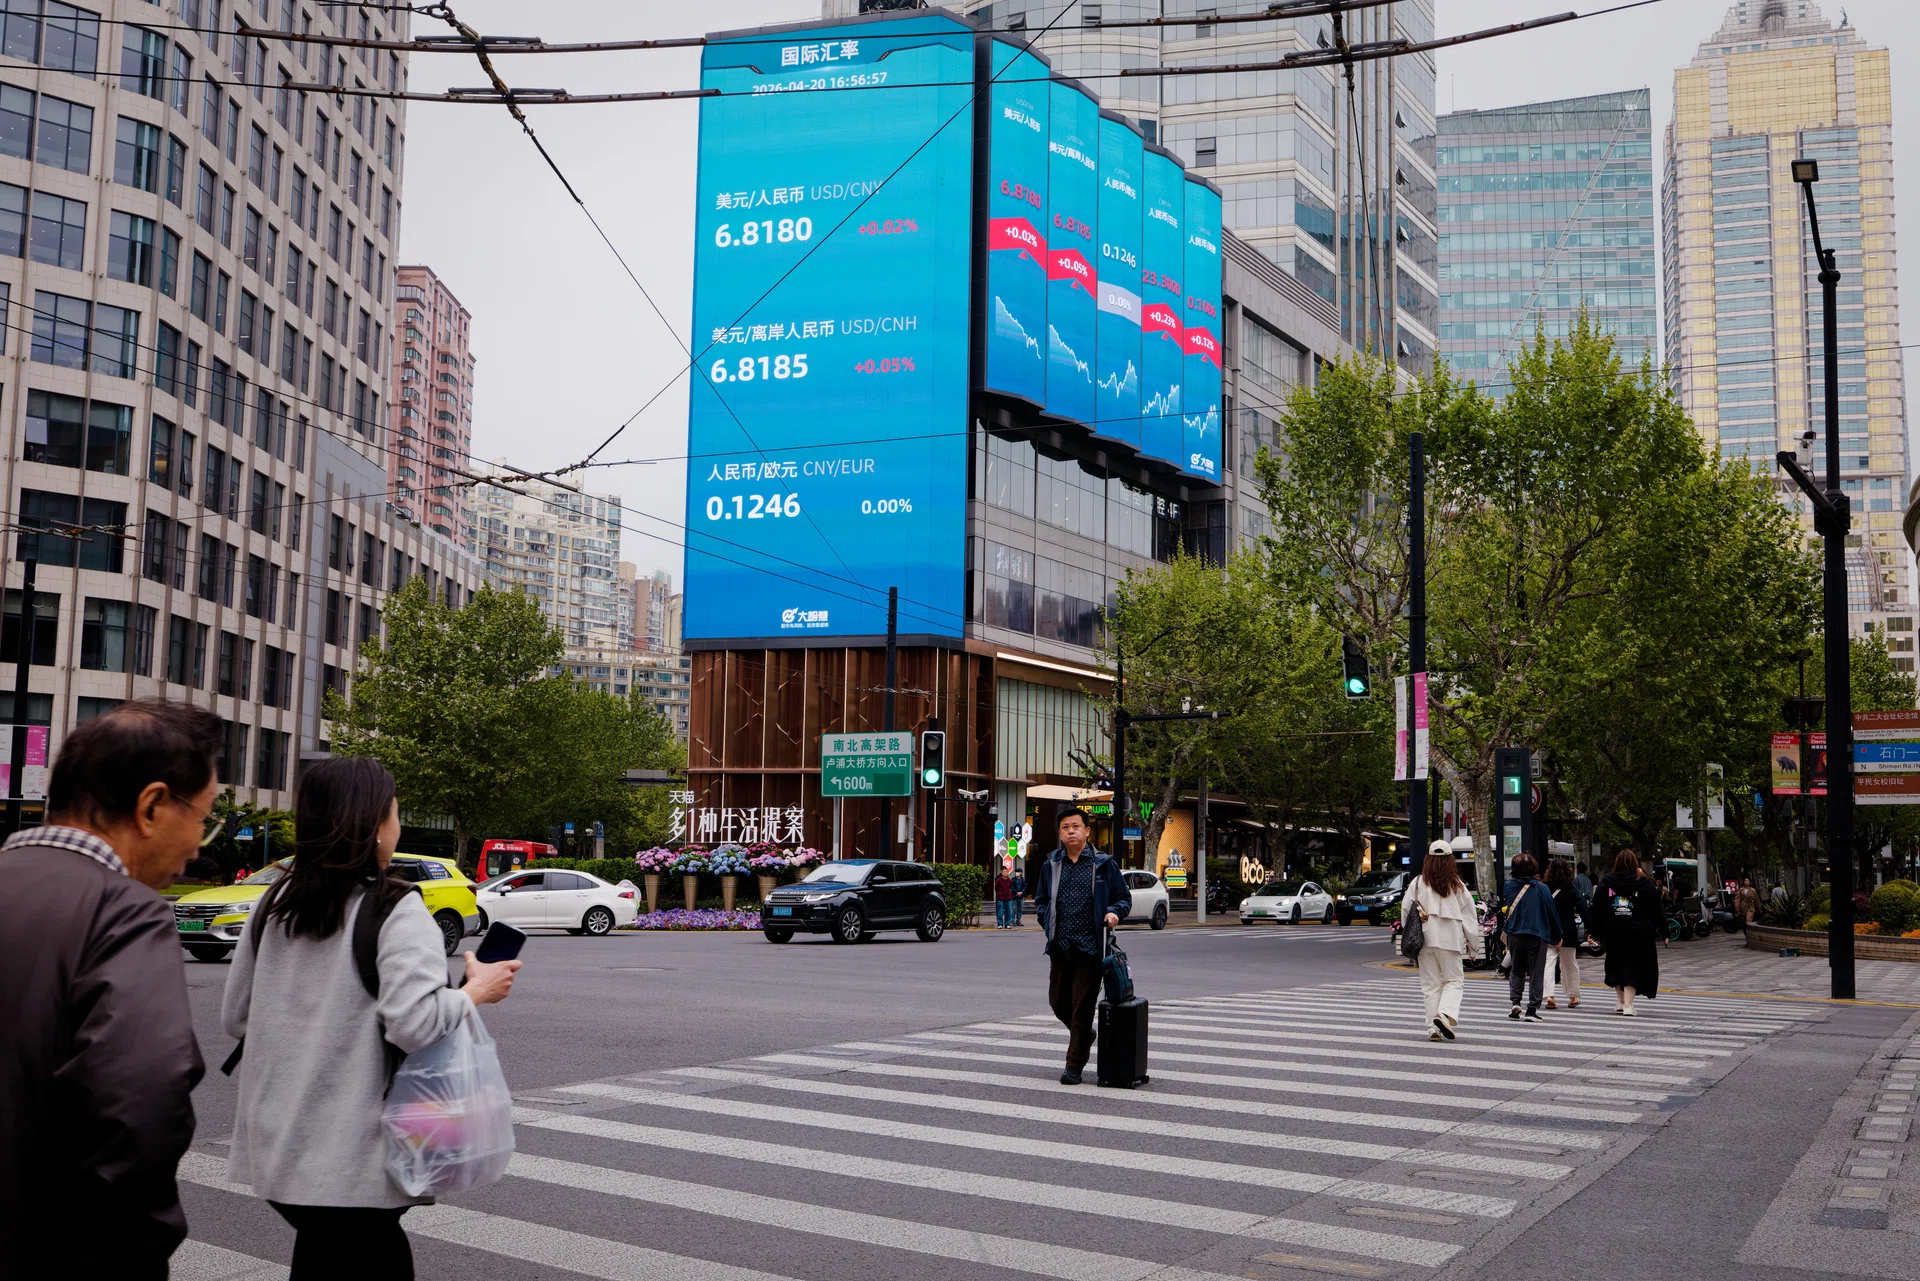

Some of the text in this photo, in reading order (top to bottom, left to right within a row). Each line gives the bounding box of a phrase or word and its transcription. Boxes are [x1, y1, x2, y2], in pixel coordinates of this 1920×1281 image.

[781, 40, 859, 67] 国际汇率
[752, 72, 887, 97] 2026-04-20 16:56:57
[1004, 107, 1040, 132] 美元/人民币
[715, 180, 883, 210] 美元/人民币 USD/CNY
[1001, 180, 1041, 209] 6.8180
[715, 217, 812, 248] 6.8180
[858, 218, 918, 236] +0.02%
[1005, 227, 1037, 247] +0.02%
[1054, 214, 1091, 240] 6.8185
[1102, 243, 1136, 268] 0.1246
[1058, 258, 1088, 277] +0.05%
[1142, 269, 1180, 296] 23.3000
[1109, 295, 1132, 311] 0.00%
[711, 315, 916, 344] 美元/离岸人民币 USD/CNH
[1150, 312, 1176, 328] +0.23%
[1191, 335, 1214, 351] +0.12%
[710, 353, 808, 383] 6.8185
[854, 357, 915, 374] +0.05%
[707, 458, 874, 482] 人民币/欧元 CNY/EUR
[706, 492, 800, 521] 0.1246
[861, 498, 912, 515] 0.00%
[1855, 712, 1919, 721] 中共二大会址纪念馆
[833, 738, 900, 752] 南北高架路
[1880, 747, 1919, 759] 石门一
[826, 758, 907, 769] 卢浦大桥方向入口
[844, 776, 872, 790] 600m
[669, 790, 695, 804] 天猫
[665, 806, 805, 844] 多1种生活提案
[492, 843, 505, 851] JDL
